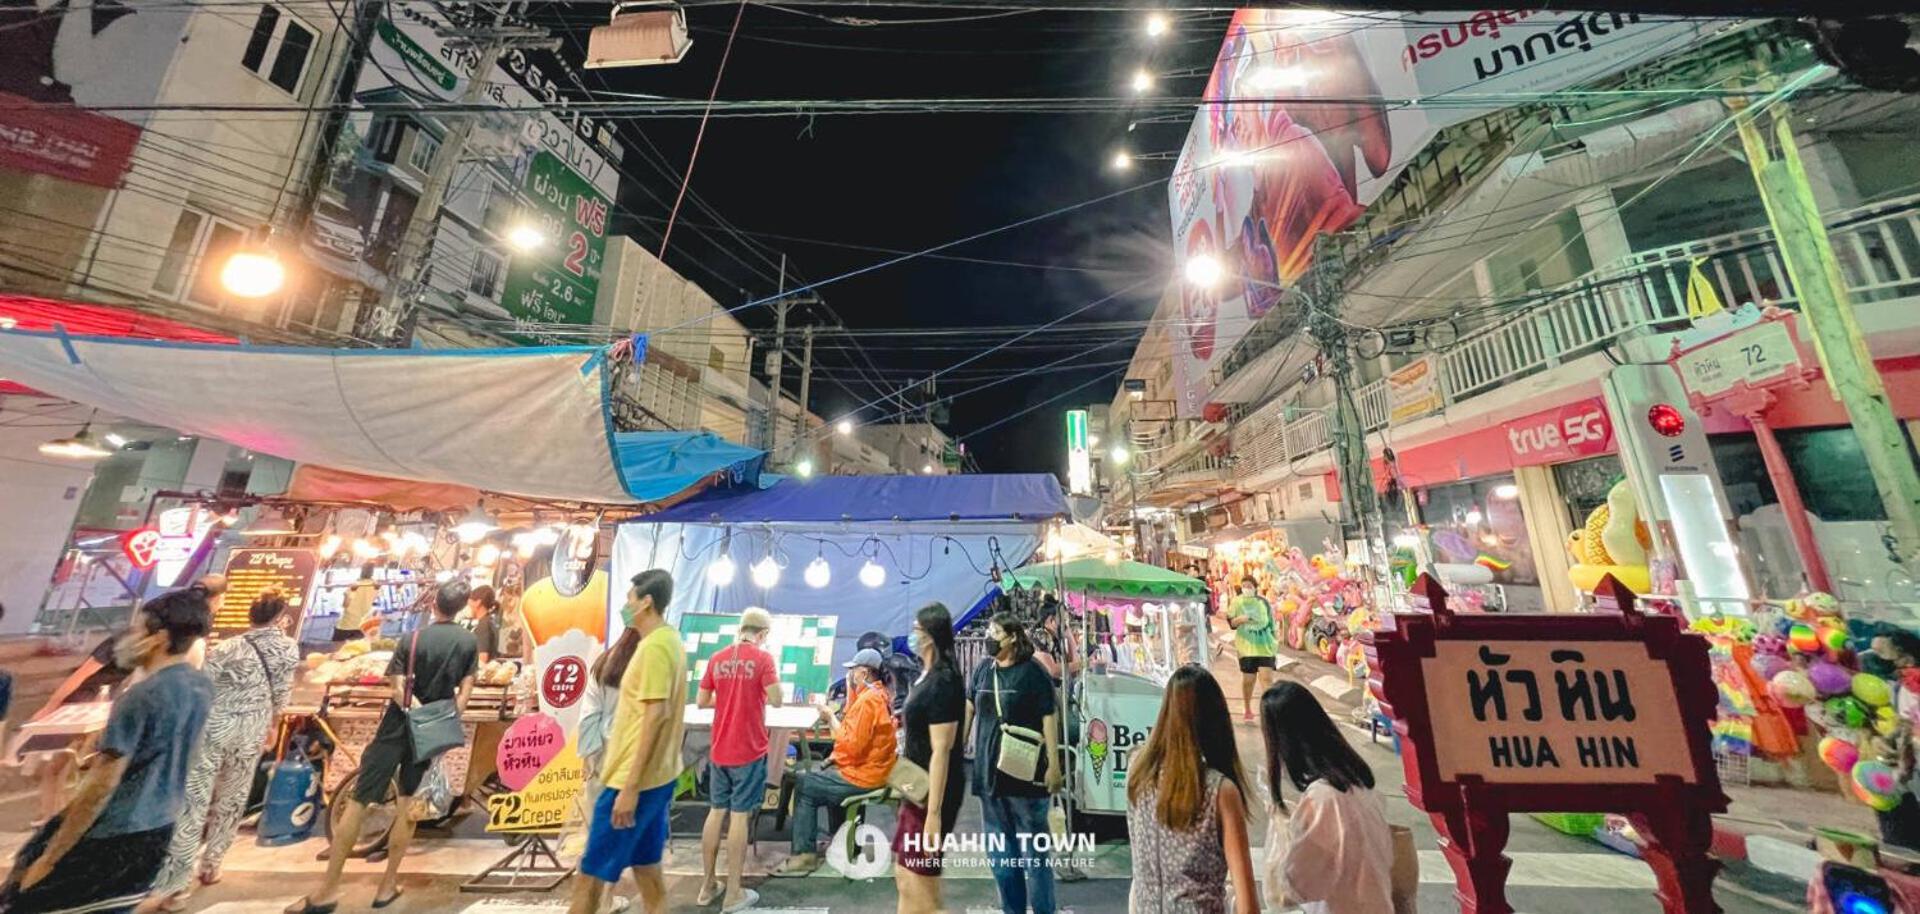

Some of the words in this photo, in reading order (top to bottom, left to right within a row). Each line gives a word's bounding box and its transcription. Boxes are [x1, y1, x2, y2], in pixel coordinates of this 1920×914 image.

[575, 194, 607, 237] ฟรี
[563, 229, 588, 278] 2
[1740, 344, 1767, 366] 72
[1508, 426, 1560, 454] true
[1564, 411, 1605, 445] 5G
[554, 663, 579, 683] 72
[504, 724, 554, 751] มาเที่ยว
[1489, 736, 1560, 768] HUA
[1576, 736, 1639, 768] HIN
[503, 752, 541, 771] หัวหิน
[491, 795, 521, 826] 72
